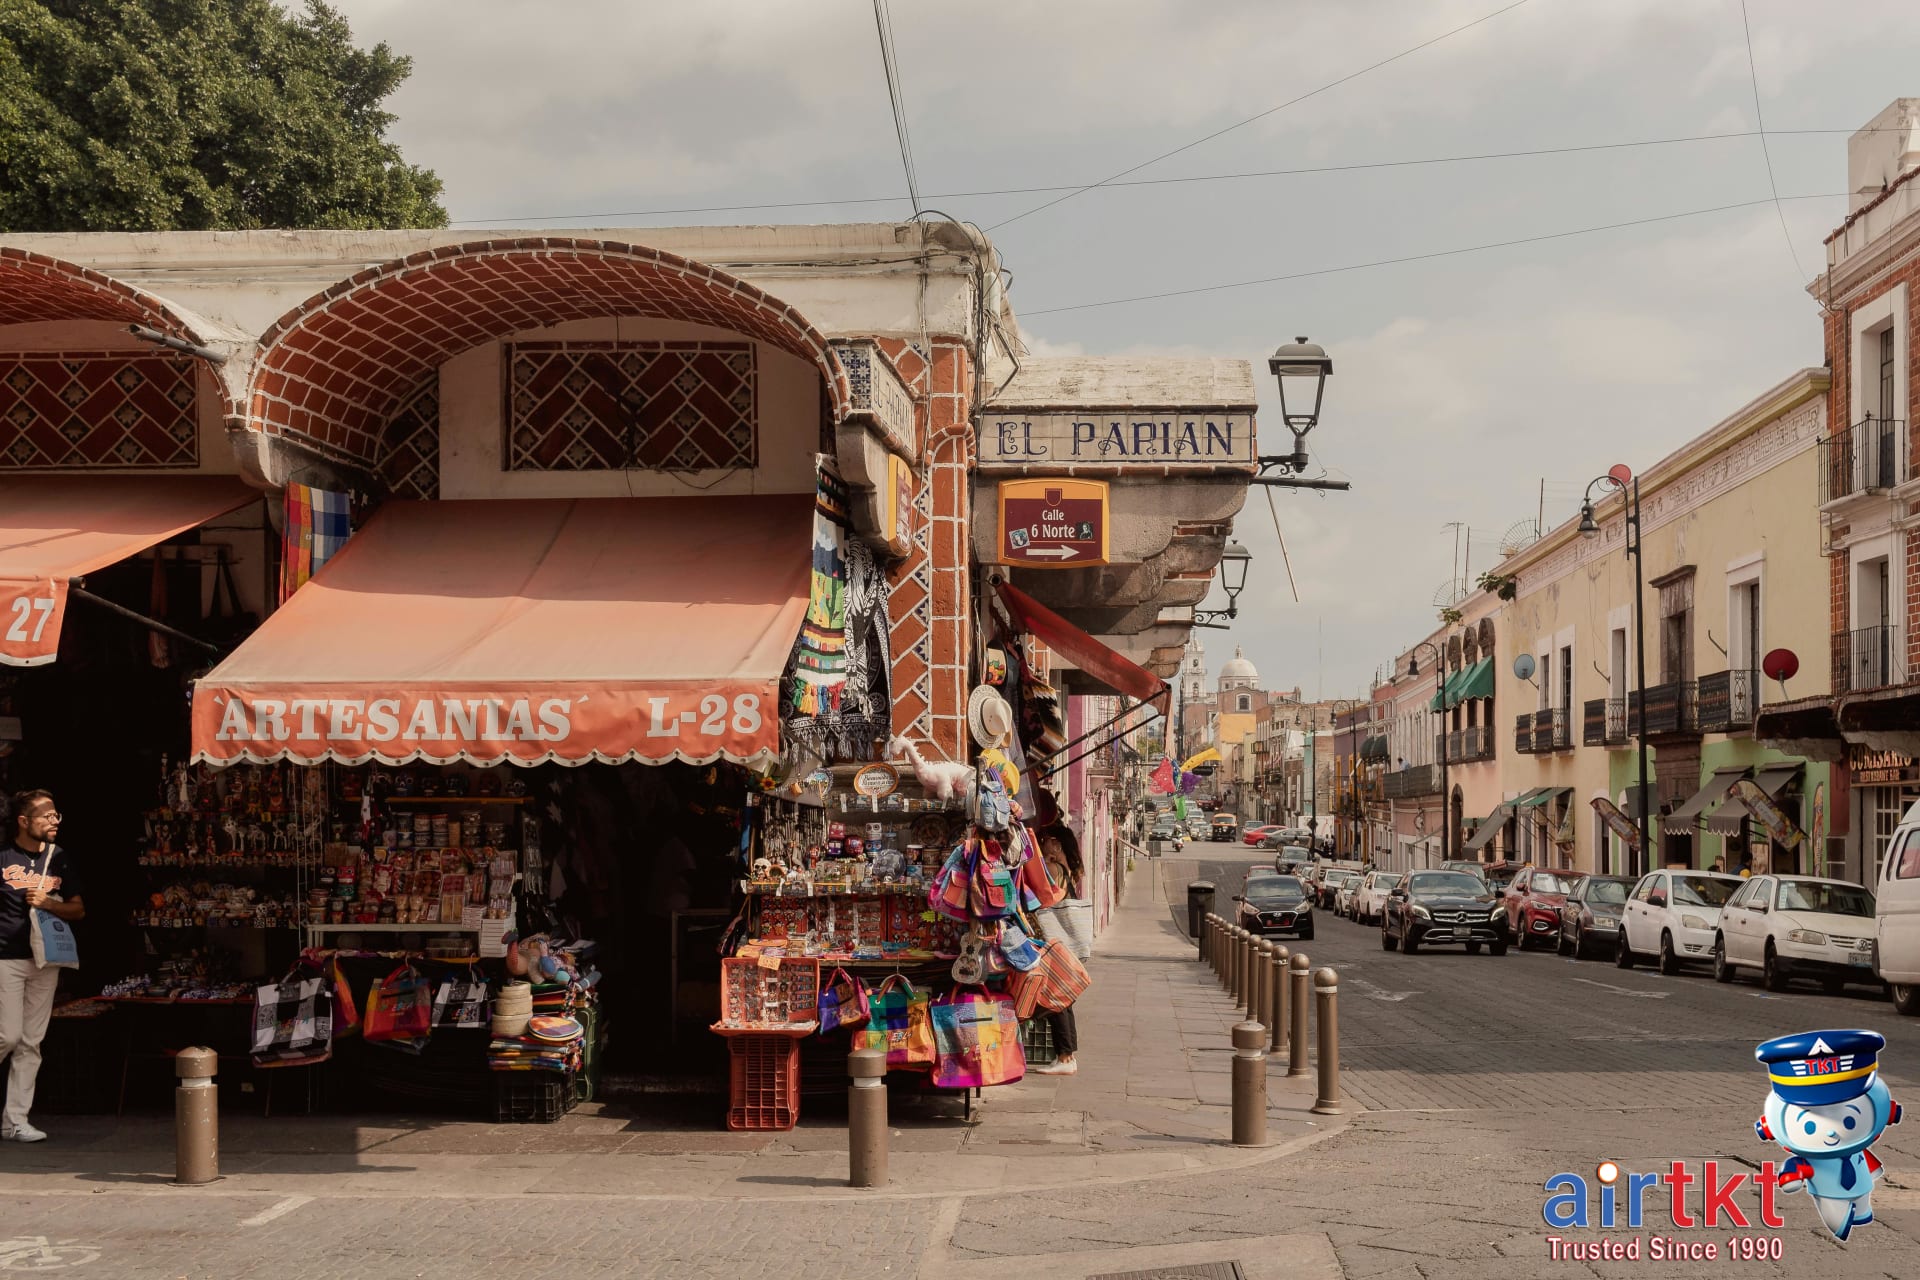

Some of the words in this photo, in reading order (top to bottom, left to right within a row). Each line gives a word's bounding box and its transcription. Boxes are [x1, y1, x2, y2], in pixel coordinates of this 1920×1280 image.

[996, 421, 1047, 456] EL
[1071, 421, 1234, 456] PARIAN
[1031, 523, 1039, 538] 6
[1042, 523, 1076, 538] Norte
[1042, 508, 1065, 521] Calle
[5, 596, 55, 642] 27
[646, 693, 762, 738] L-28
